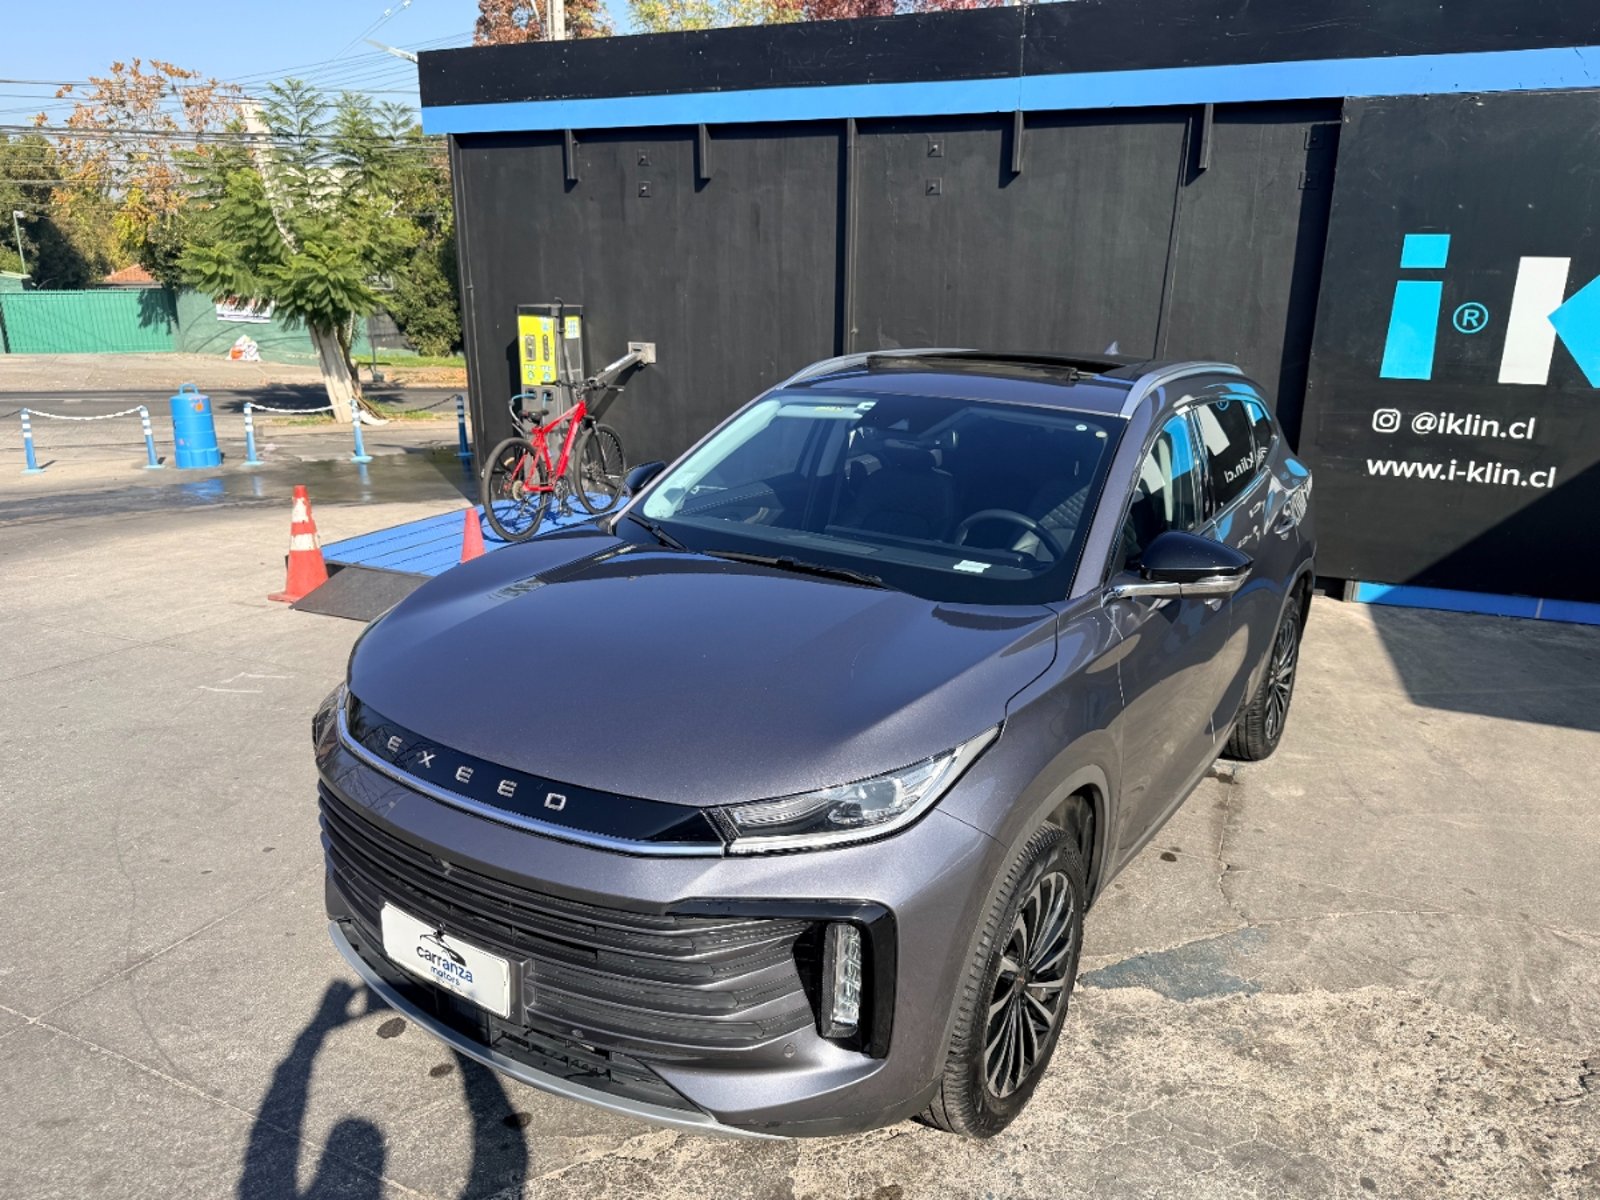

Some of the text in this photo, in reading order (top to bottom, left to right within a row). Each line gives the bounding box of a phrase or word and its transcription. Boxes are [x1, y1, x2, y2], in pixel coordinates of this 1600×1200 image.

[1411, 411, 1536, 440] @iklin.cl
[1366, 458, 1557, 488] www.i-klin.cl
[416, 946, 473, 983] carranza
[430, 966, 461, 986] motors
